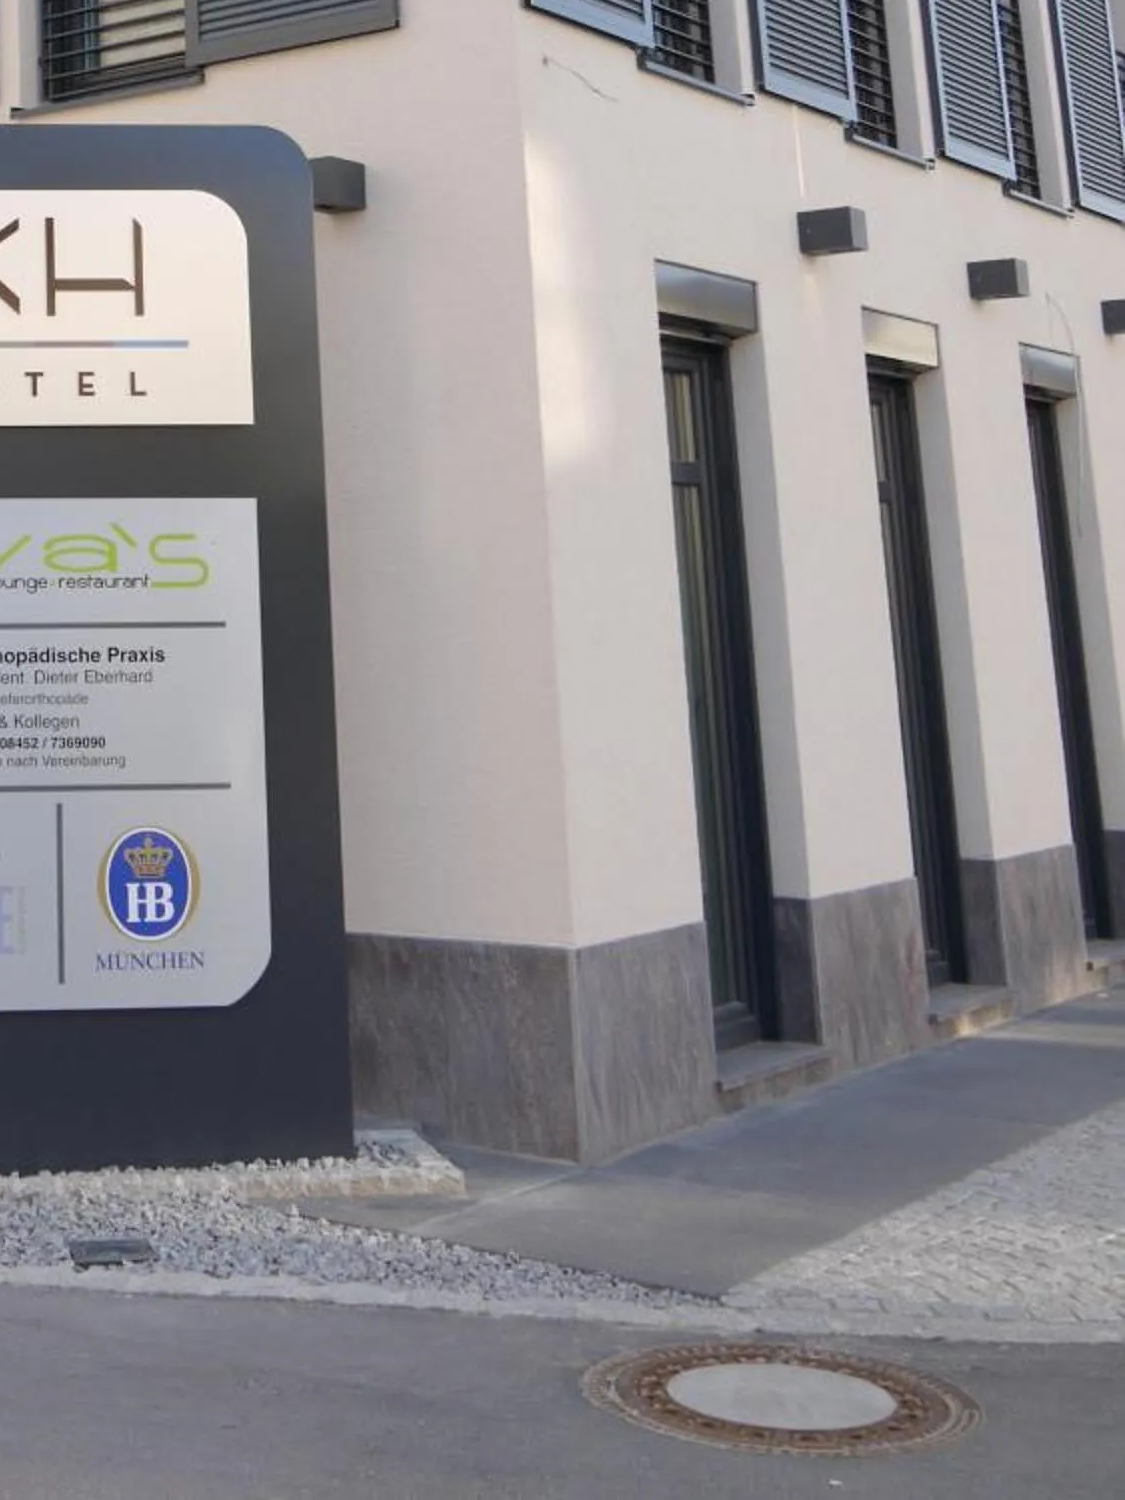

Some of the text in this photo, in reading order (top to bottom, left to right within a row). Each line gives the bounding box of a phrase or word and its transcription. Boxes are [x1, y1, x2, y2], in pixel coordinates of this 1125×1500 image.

[58, 573, 150, 590] restaurant
[107, 645, 166, 663] Praxis
[84, 669, 154, 684] Eberhard
[13, 714, 80, 731] Kollegen
[7, 754, 38, 767] nach
[125, 882, 175, 924] HB
